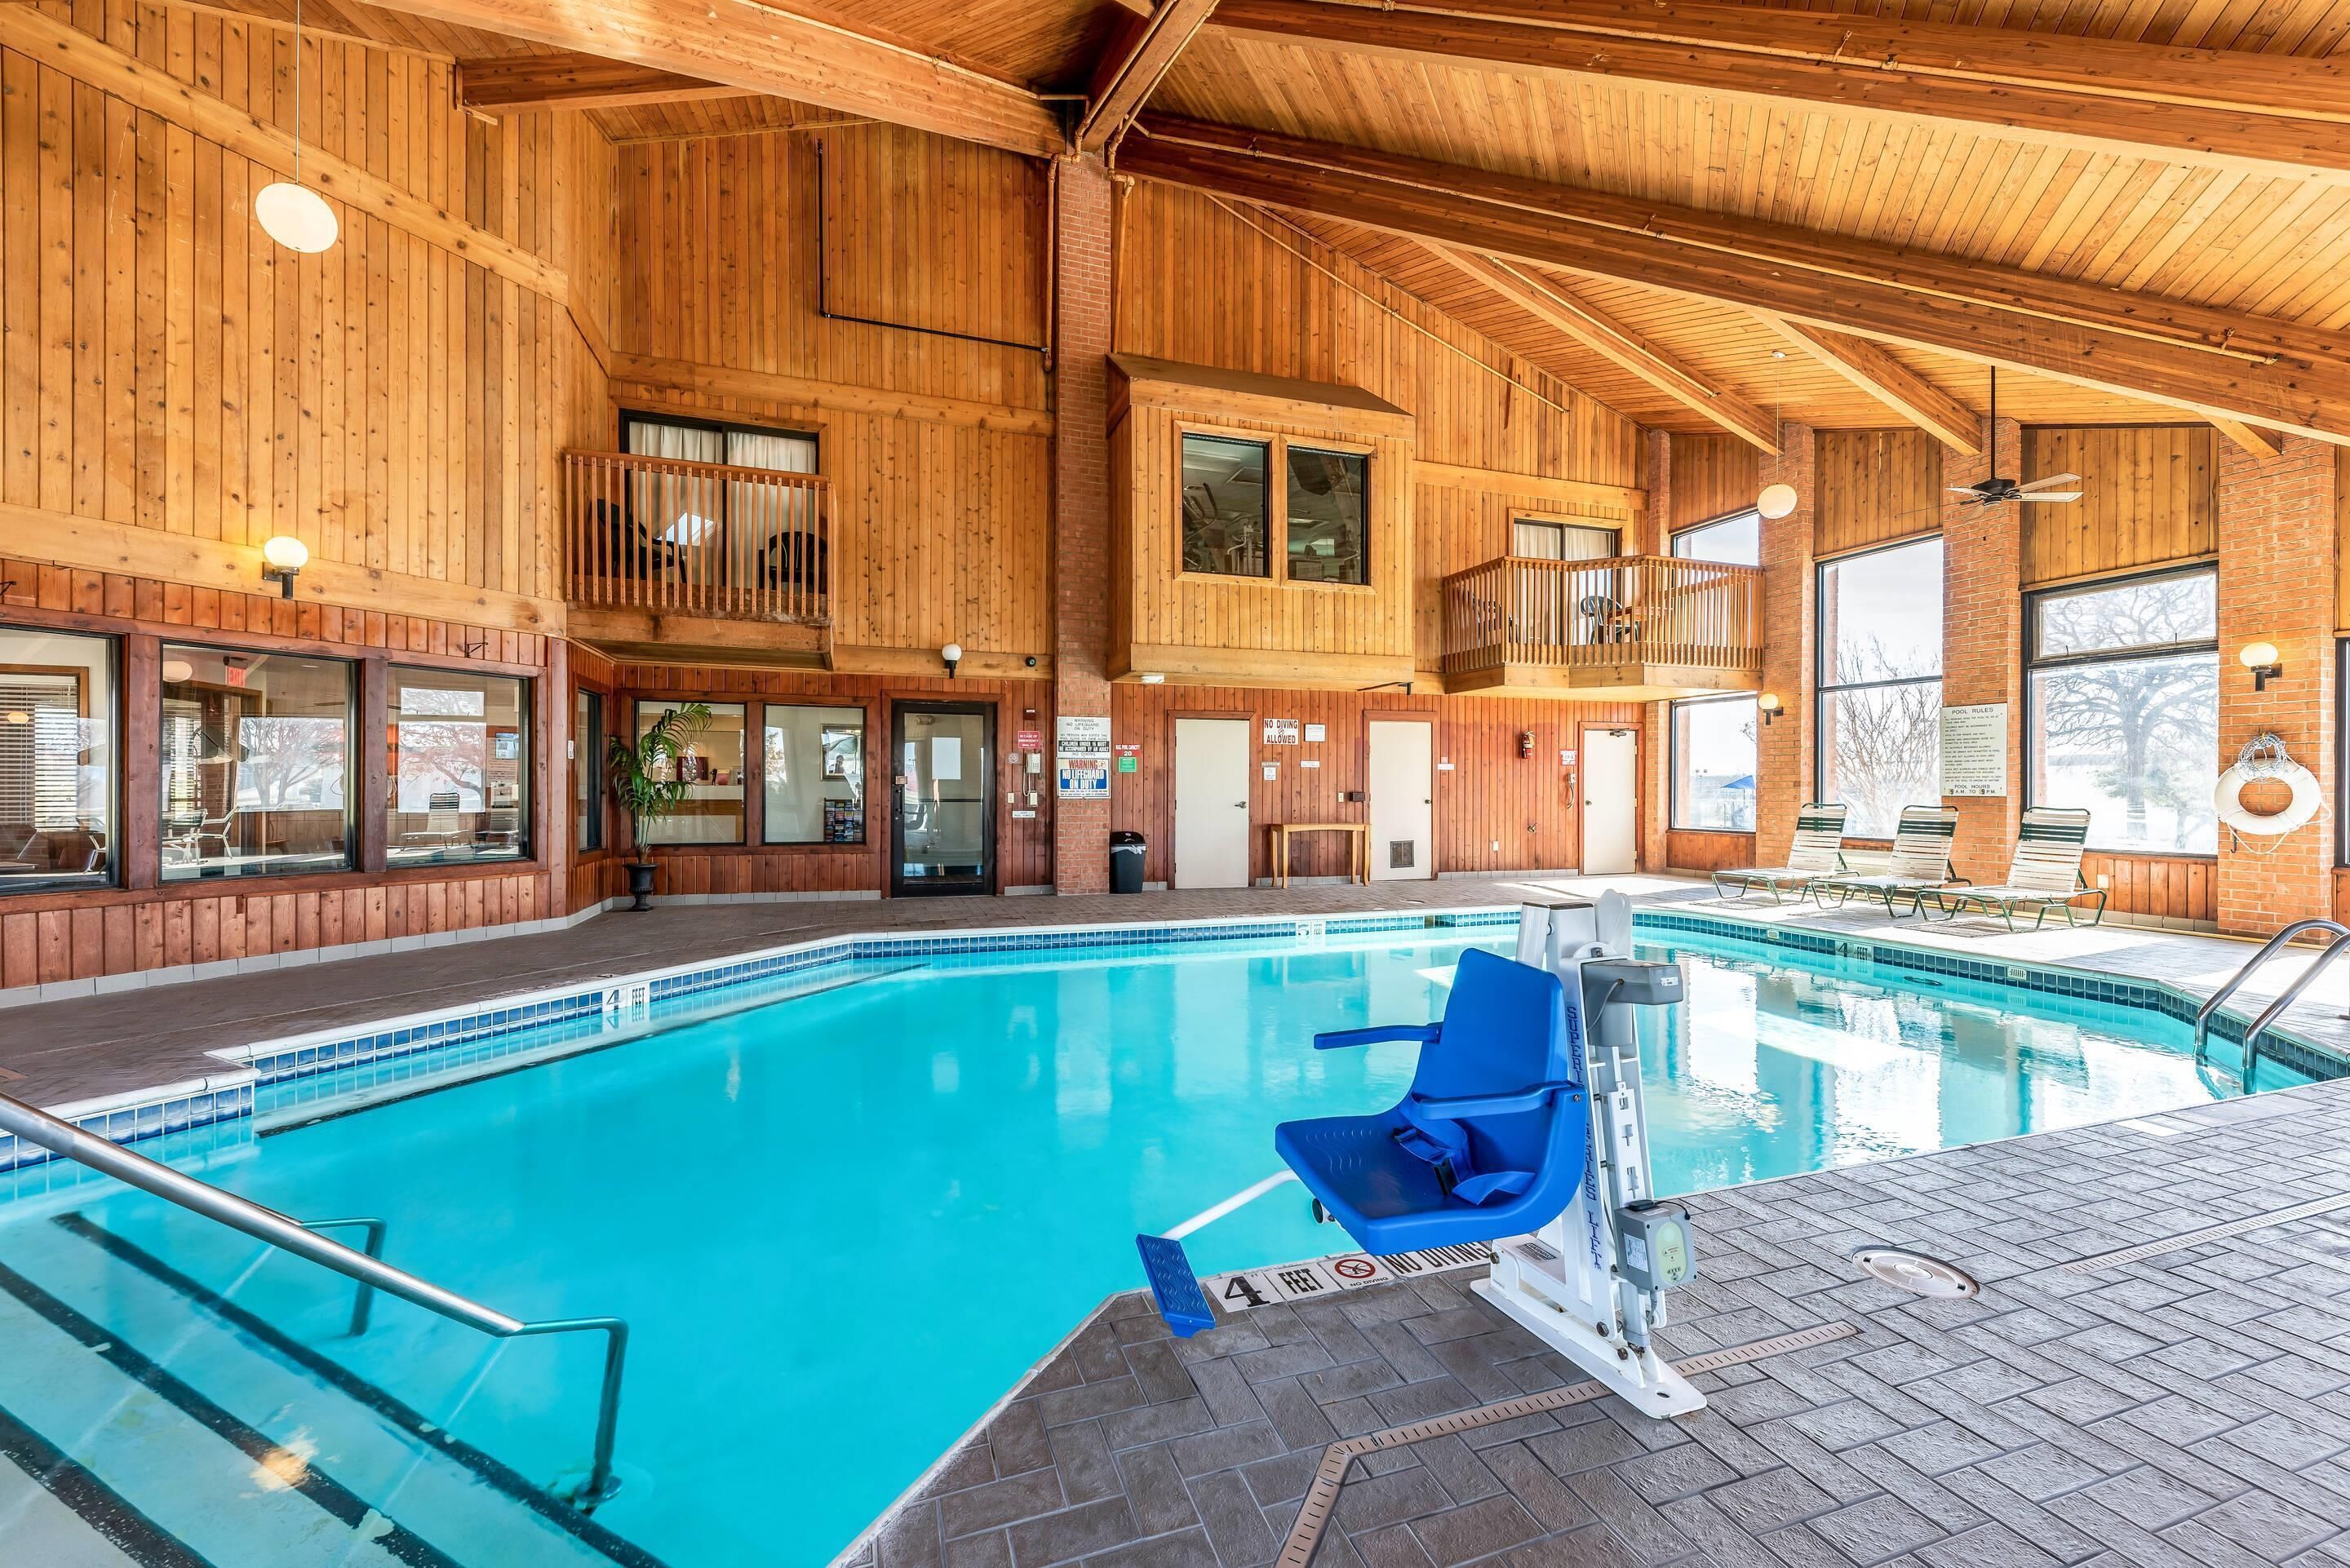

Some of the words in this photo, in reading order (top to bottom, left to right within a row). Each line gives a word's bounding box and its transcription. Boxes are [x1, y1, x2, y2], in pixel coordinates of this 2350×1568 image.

[229, 668, 245, 686] EXIT
[1264, 720, 1273, 729] NO
[1276, 720, 1297, 729] DIVING
[1266, 734, 1296, 744] ALLOWED
[1069, 760, 1097, 769] WARNING
[1062, 769, 1071, 779] NO
[1071, 769, 1104, 780] LIFEGUARD
[1070, 779, 1079, 789] ON
[1080, 779, 1097, 789] DUTY
[1298, 924, 1310, 936] 5
[1837, 942, 1849, 958] 4
[1857, 946, 1868, 960] FEET
[606, 990, 621, 1010] 4
[632, 987, 645, 1006] FEET
[1277, 1268, 1324, 1295] FEET
[1363, 1277, 1389, 1285] DIVING
[1224, 1275, 1270, 1307] 4
